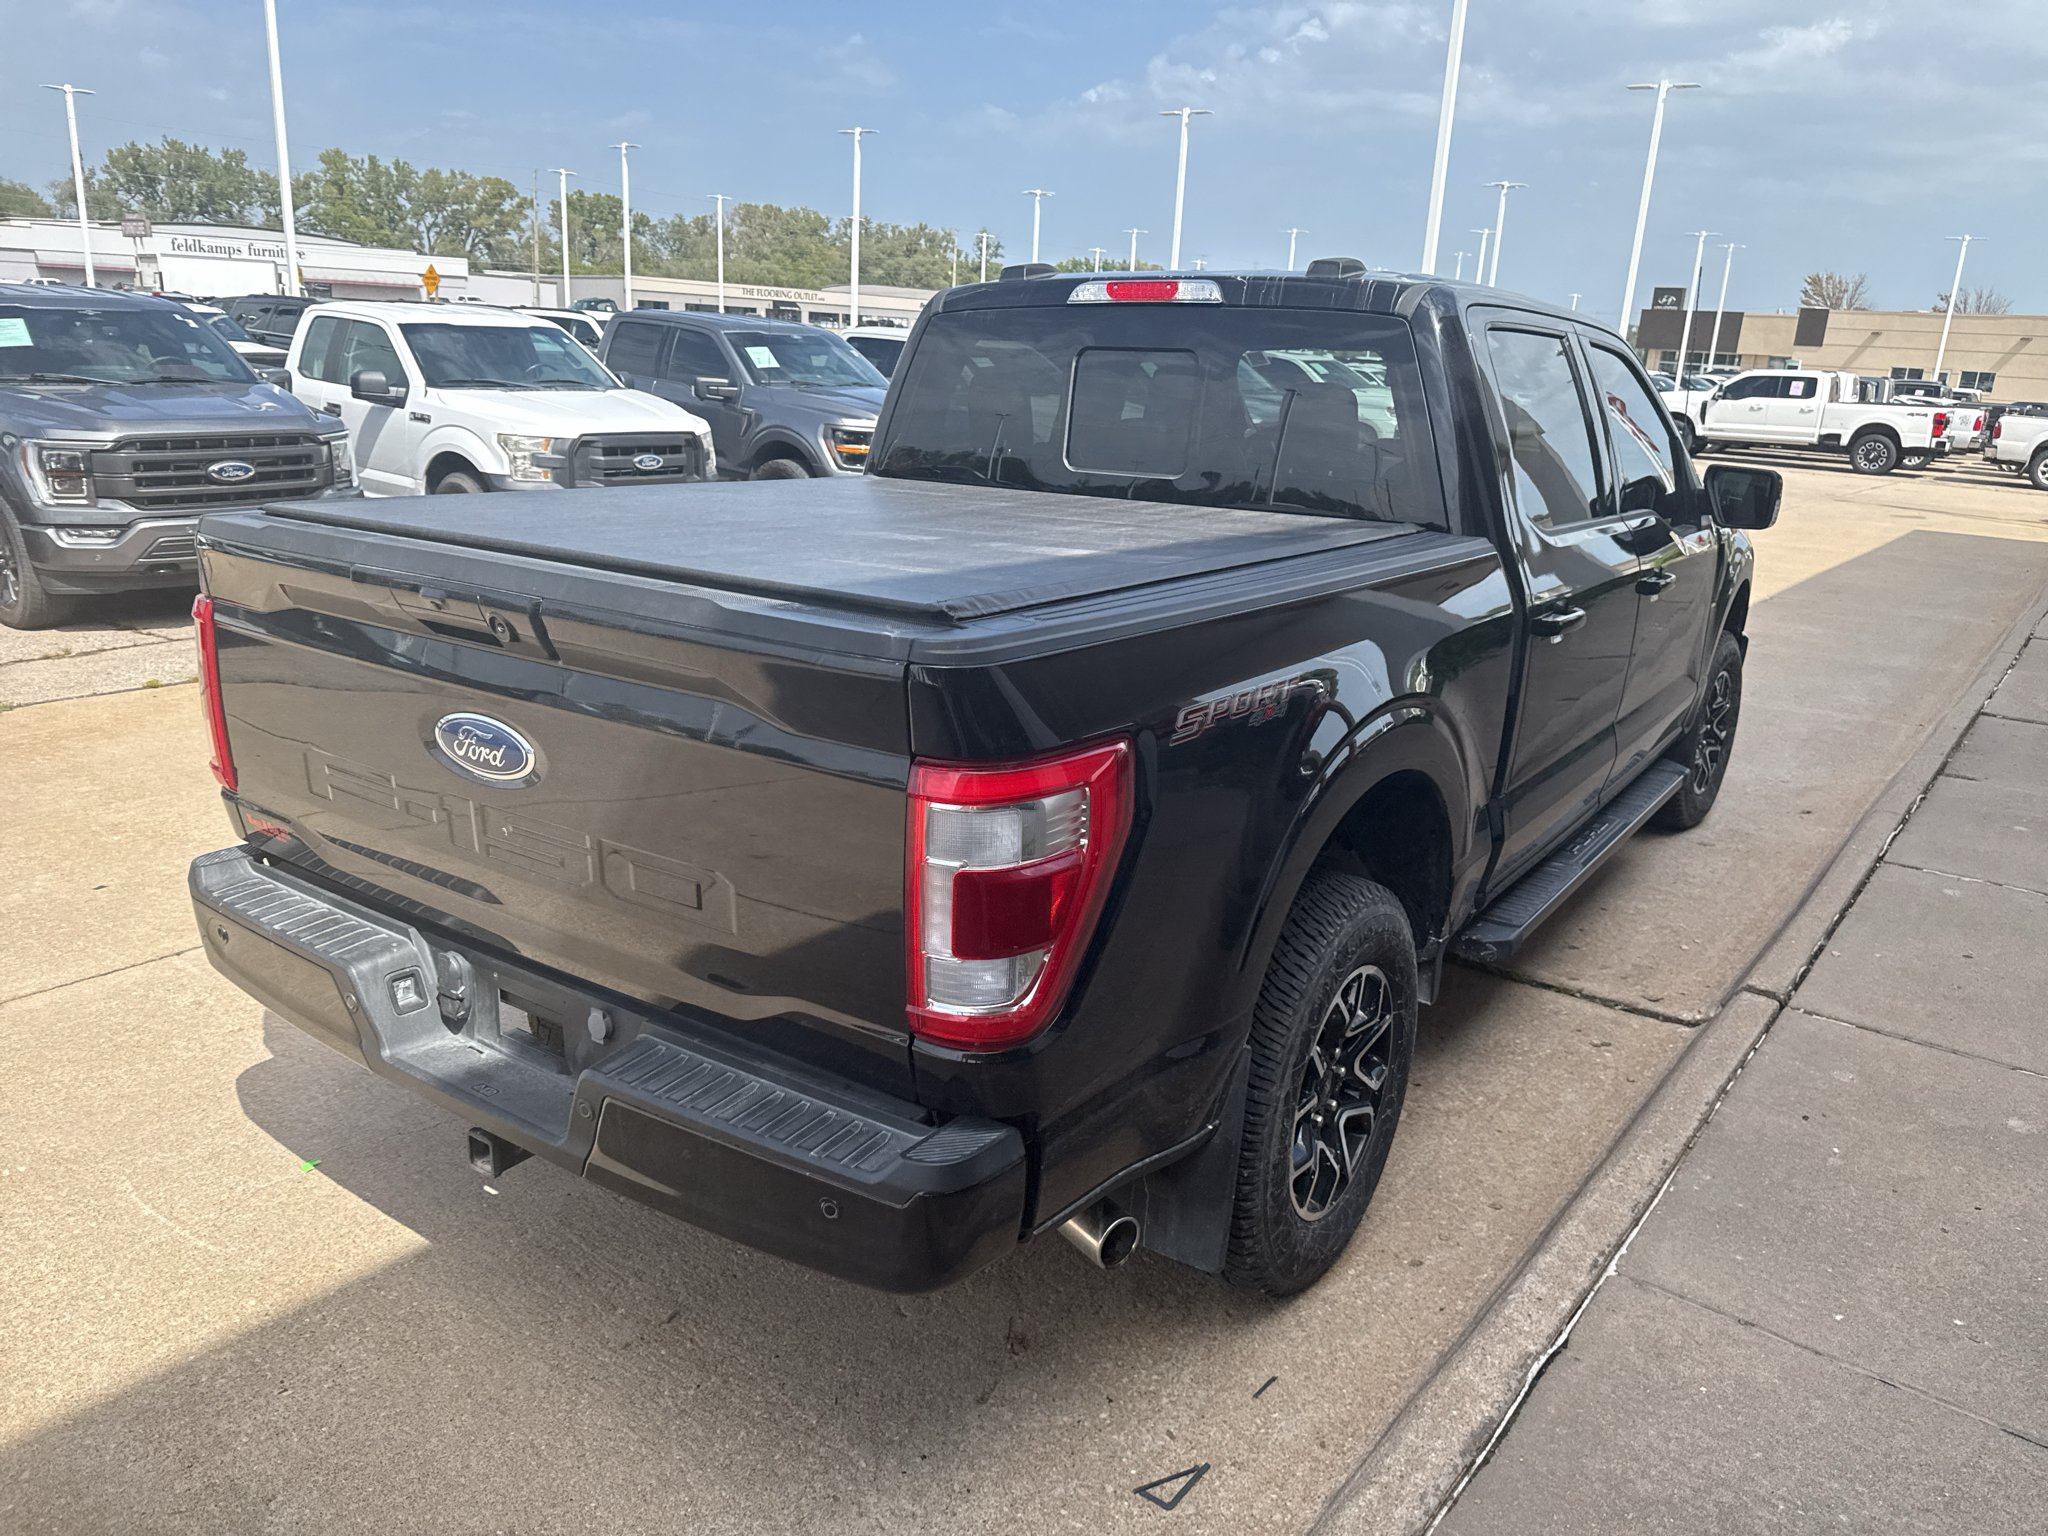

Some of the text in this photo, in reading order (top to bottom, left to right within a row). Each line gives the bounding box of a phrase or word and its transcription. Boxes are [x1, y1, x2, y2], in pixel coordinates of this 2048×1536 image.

[171, 237, 306, 260] feldkamps furnite
[742, 287, 755, 297] THE
[756, 289, 792, 300] FLOORING
[793, 291, 818, 301] OUTLET
[1169, 676, 1300, 747] SPORT
[453, 725, 506, 768] Ford
[303, 746, 738, 936] F-150
